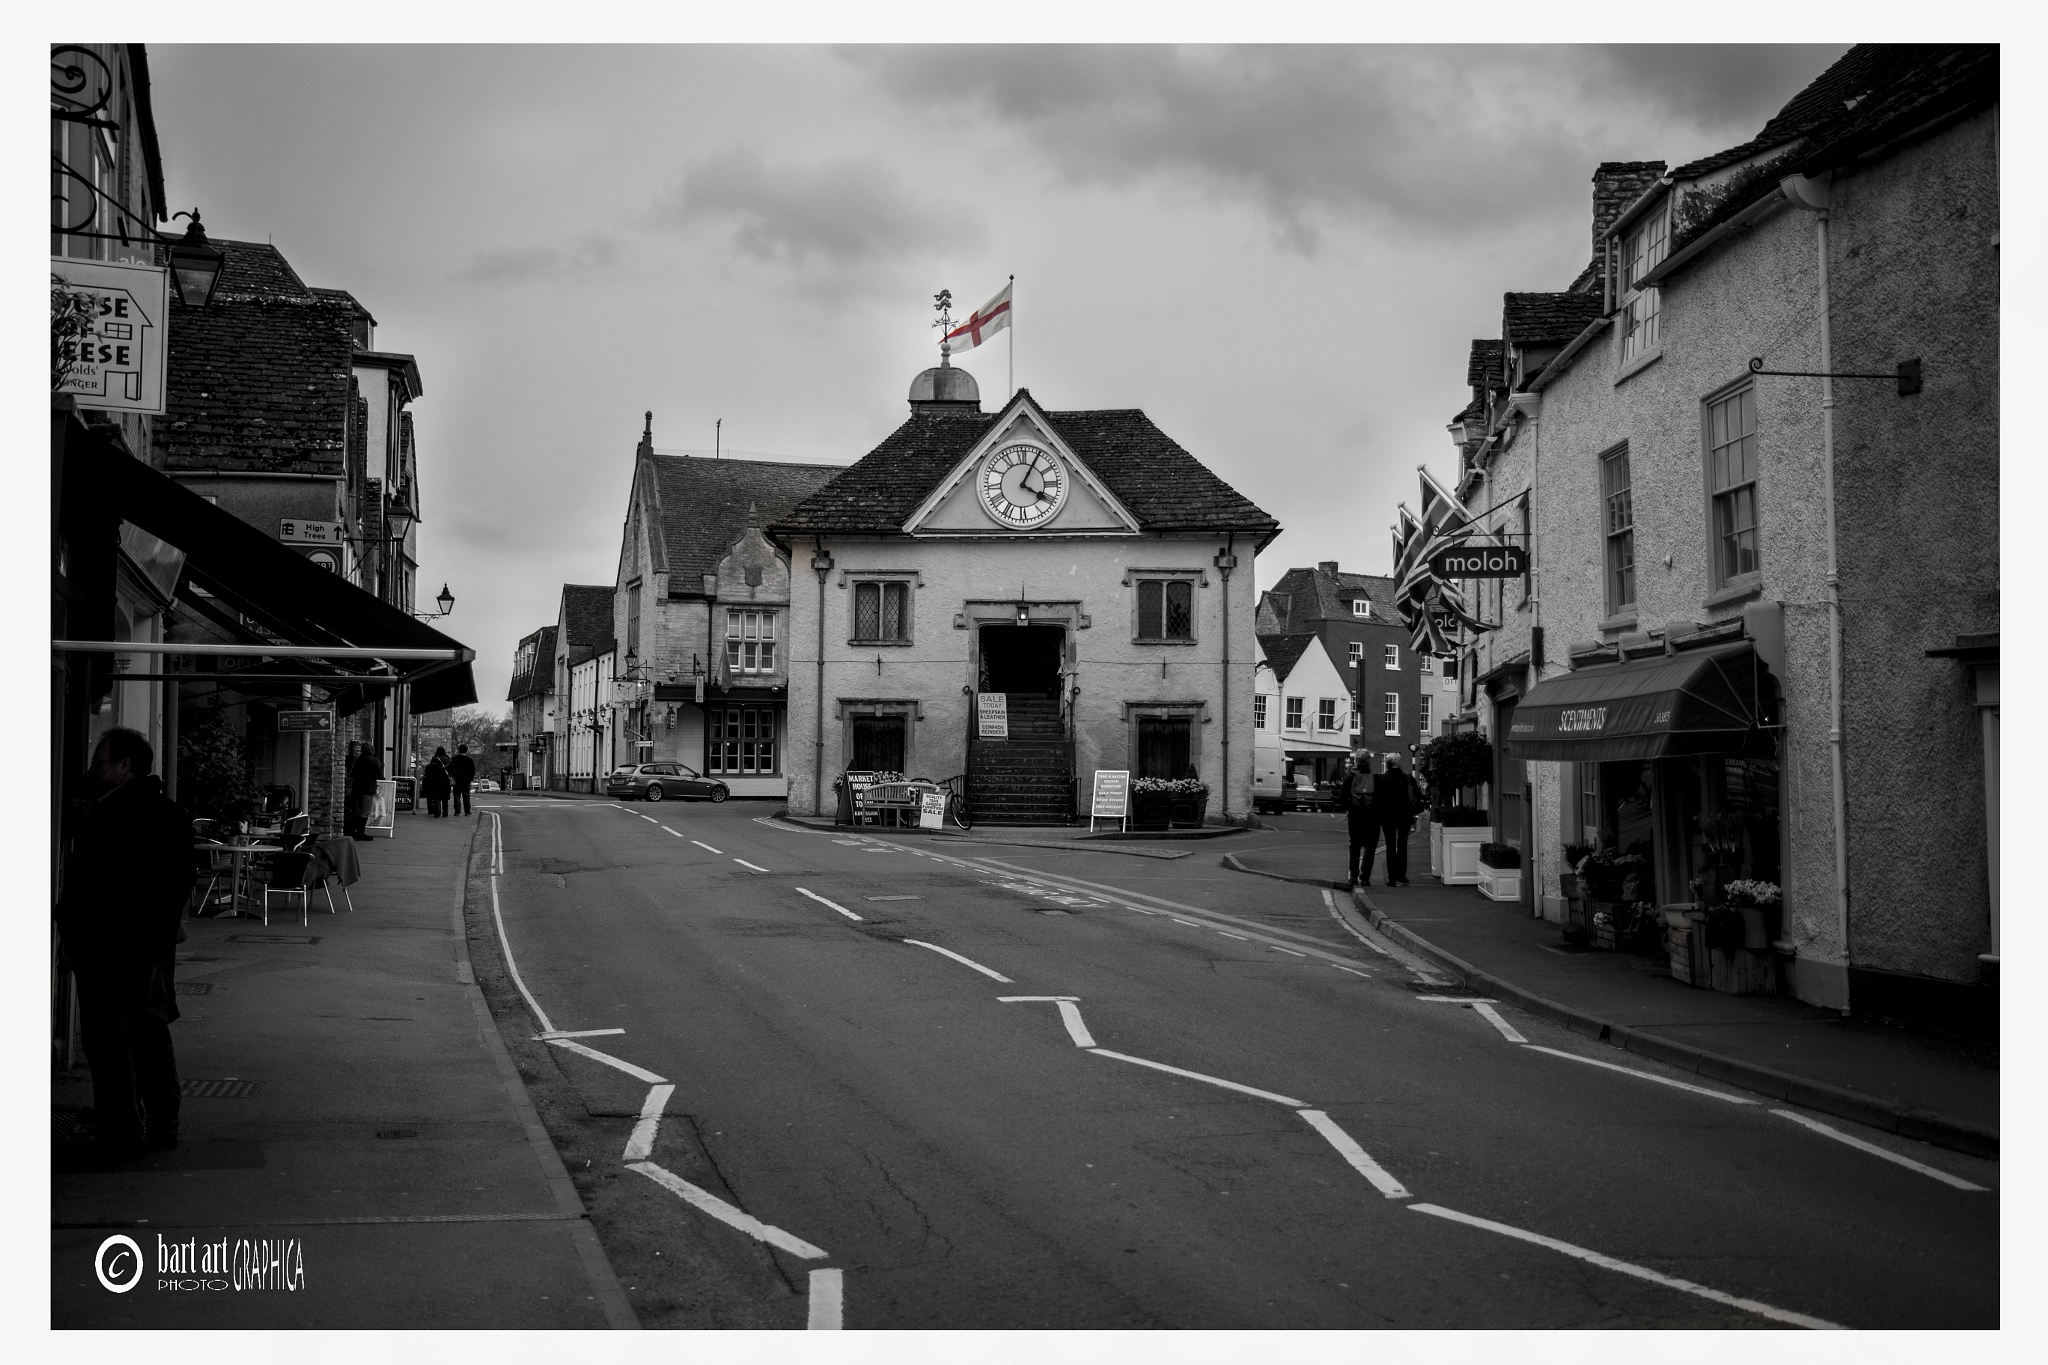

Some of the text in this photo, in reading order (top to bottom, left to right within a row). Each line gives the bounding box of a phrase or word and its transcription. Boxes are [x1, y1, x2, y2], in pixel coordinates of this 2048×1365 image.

[64, 342, 130, 366] EESE
[306, 524, 325, 532] High
[1446, 551, 1517, 572] moloh
[980, 695, 1004, 703] SALE
